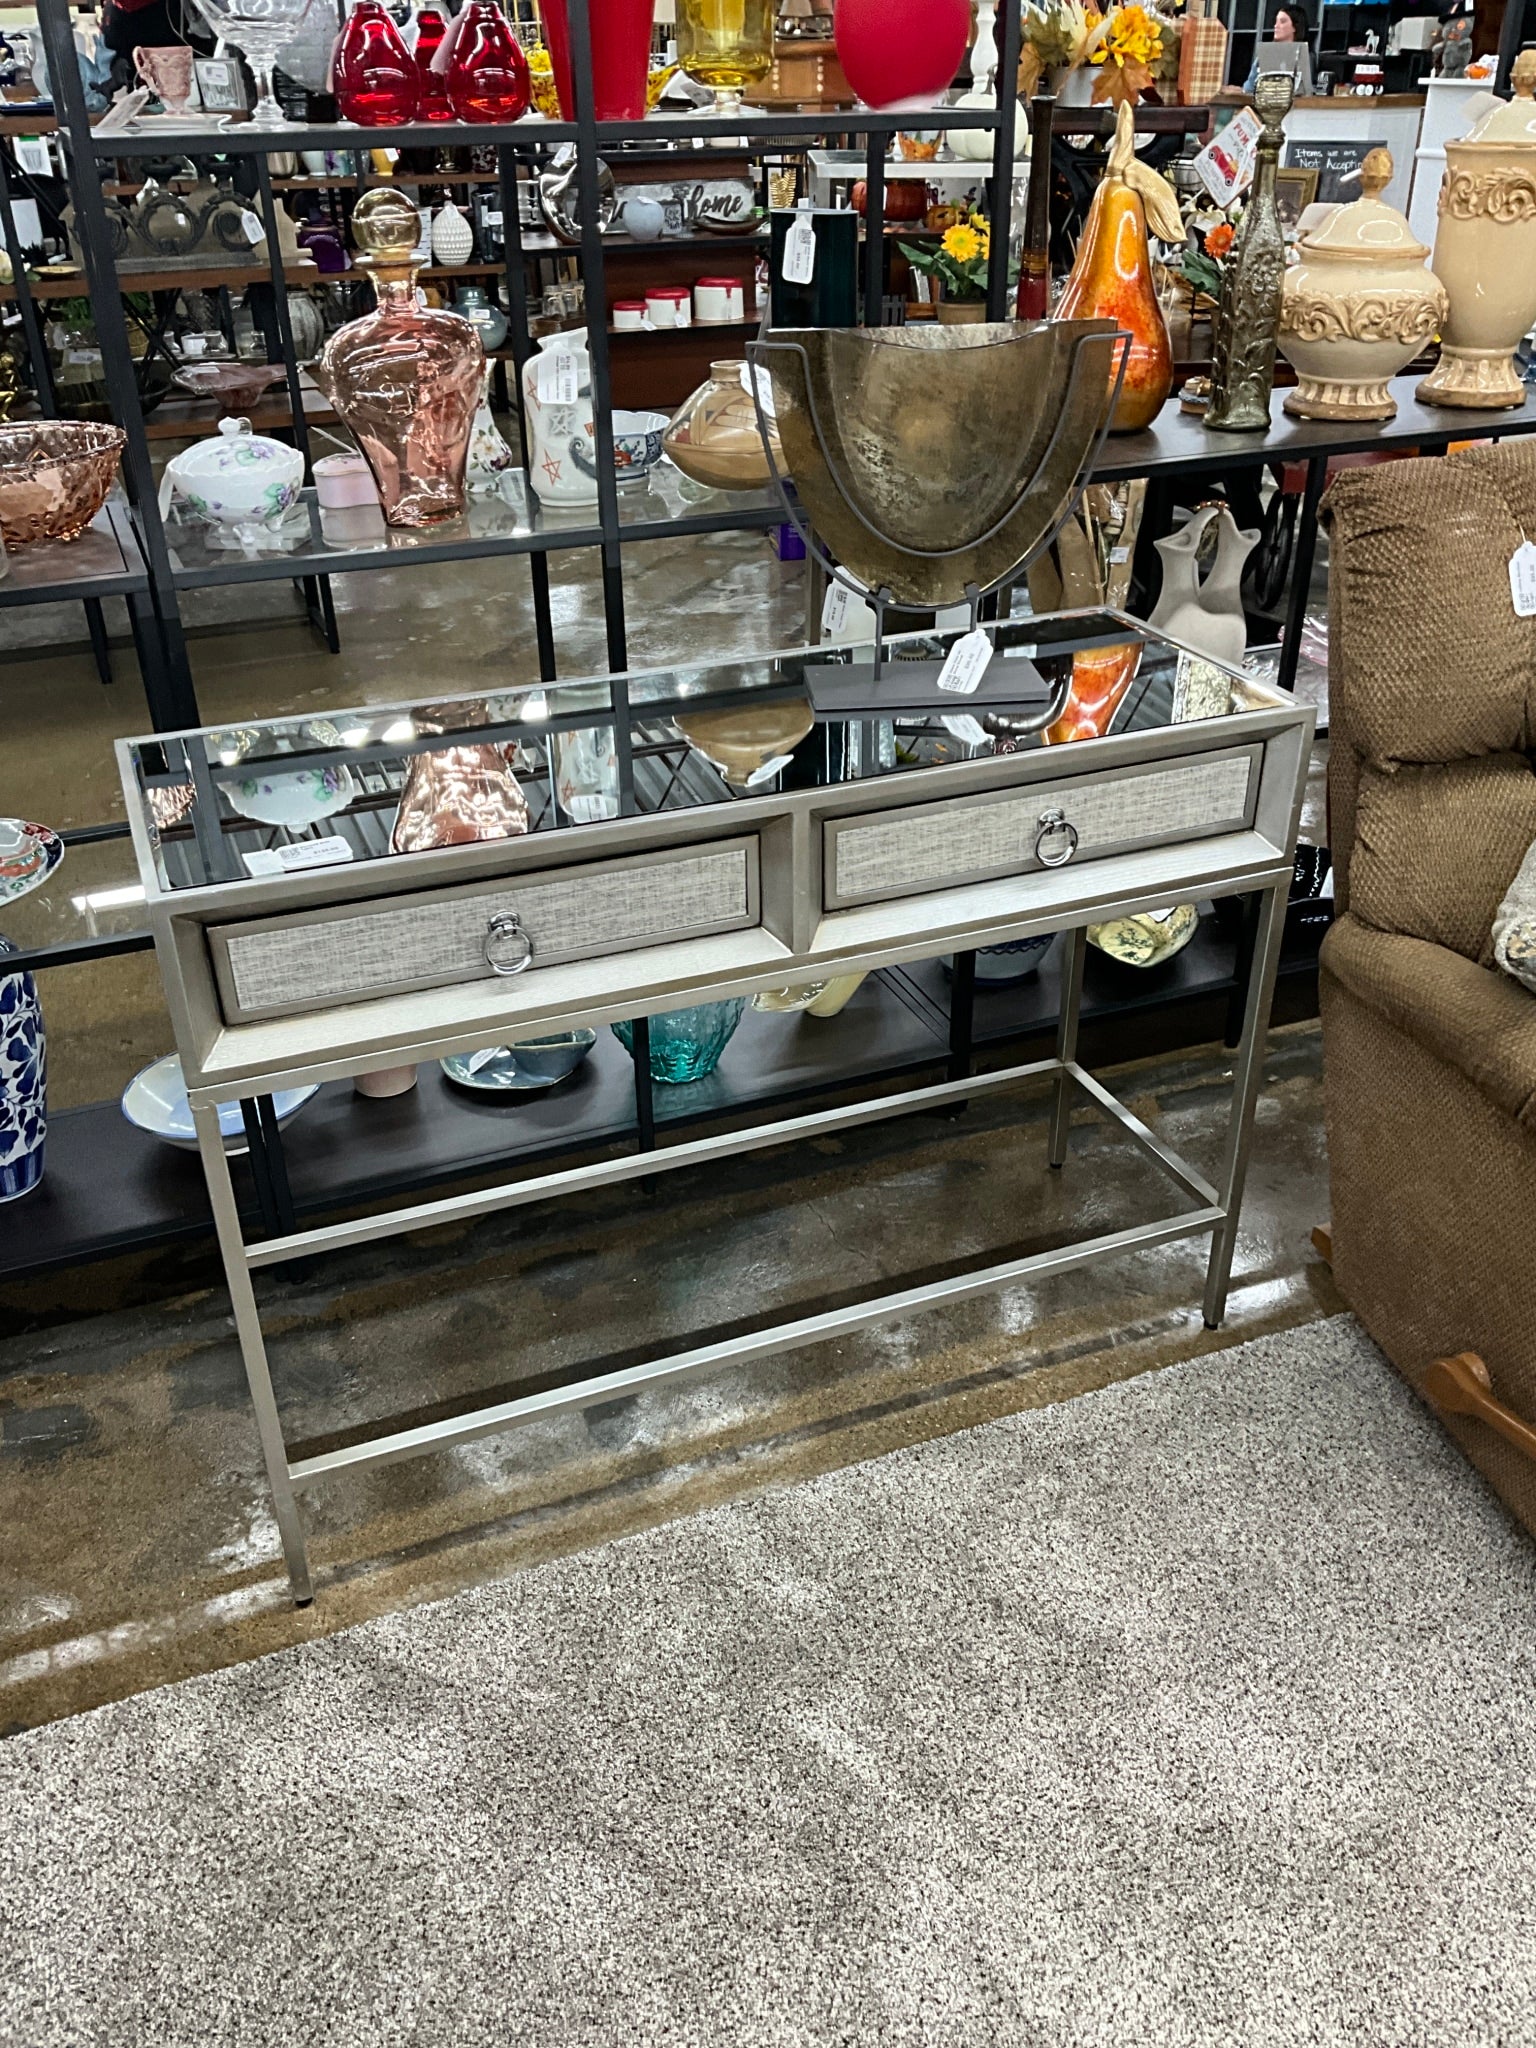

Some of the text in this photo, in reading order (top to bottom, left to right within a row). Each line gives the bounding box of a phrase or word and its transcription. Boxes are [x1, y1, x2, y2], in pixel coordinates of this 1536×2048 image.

[1294, 148, 1323, 158] Items
[1300, 157, 1363, 173] Not Acceptin
[687, 185, 743, 219] home
